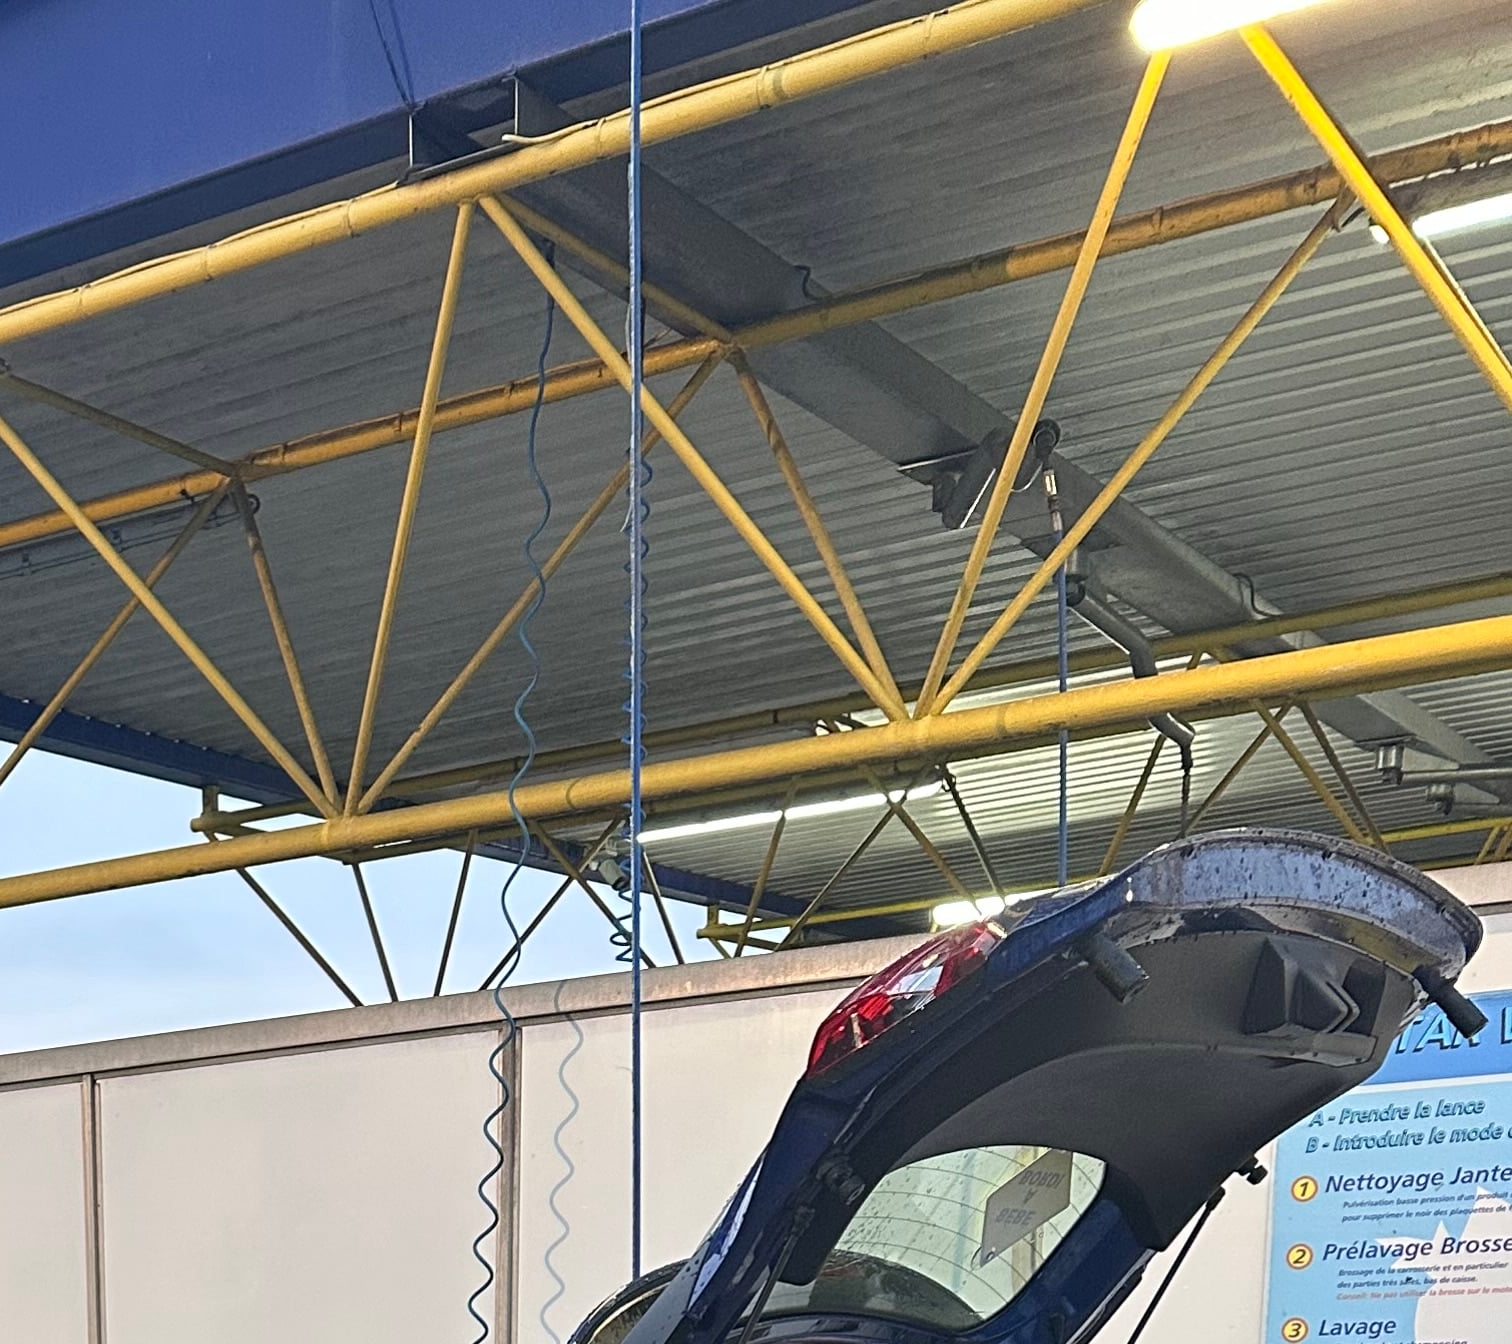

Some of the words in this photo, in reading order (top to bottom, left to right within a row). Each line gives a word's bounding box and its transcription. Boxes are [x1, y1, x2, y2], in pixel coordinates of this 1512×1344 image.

[1308, 1110, 1324, 1127] A
[1338, 1102, 1410, 1125] Prendre
[1414, 1100, 1432, 1120] la
[1435, 1099, 1486, 1118] lance
[1305, 1136, 1320, 1153] B
[1333, 1128, 1425, 1152] Introduire
[1428, 1127, 1446, 1145] le
[1449, 1122, 1503, 1143] mode
[1299, 1181, 1309, 1197] 1
[1325, 1169, 1444, 1195] Nettoyage
[1343, 1199, 1394, 1208] Pulvérisation
[1420, 1195, 1455, 1205] pression
[1476, 1192, 1508, 1201] produit
[1341, 1214, 1362, 1223] pour
[1363, 1212, 1405, 1221] supprimer
[1415, 1209, 1432, 1217] noir
[1449, 1206, 1494, 1216] plaquettes
[1292, 1248, 1307, 1264] 2
[1322, 1240, 1433, 1261] Prélavage
[1440, 1237, 1512, 1255] Brosse
[1338, 1268, 1374, 1277] Brossage
[1465, 1261, 1509, 1271] particulier
[1352, 1280, 1380, 1289] parties
[1290, 1323, 1302, 1339] 3
[1318, 1319, 1397, 1339] Lavage
